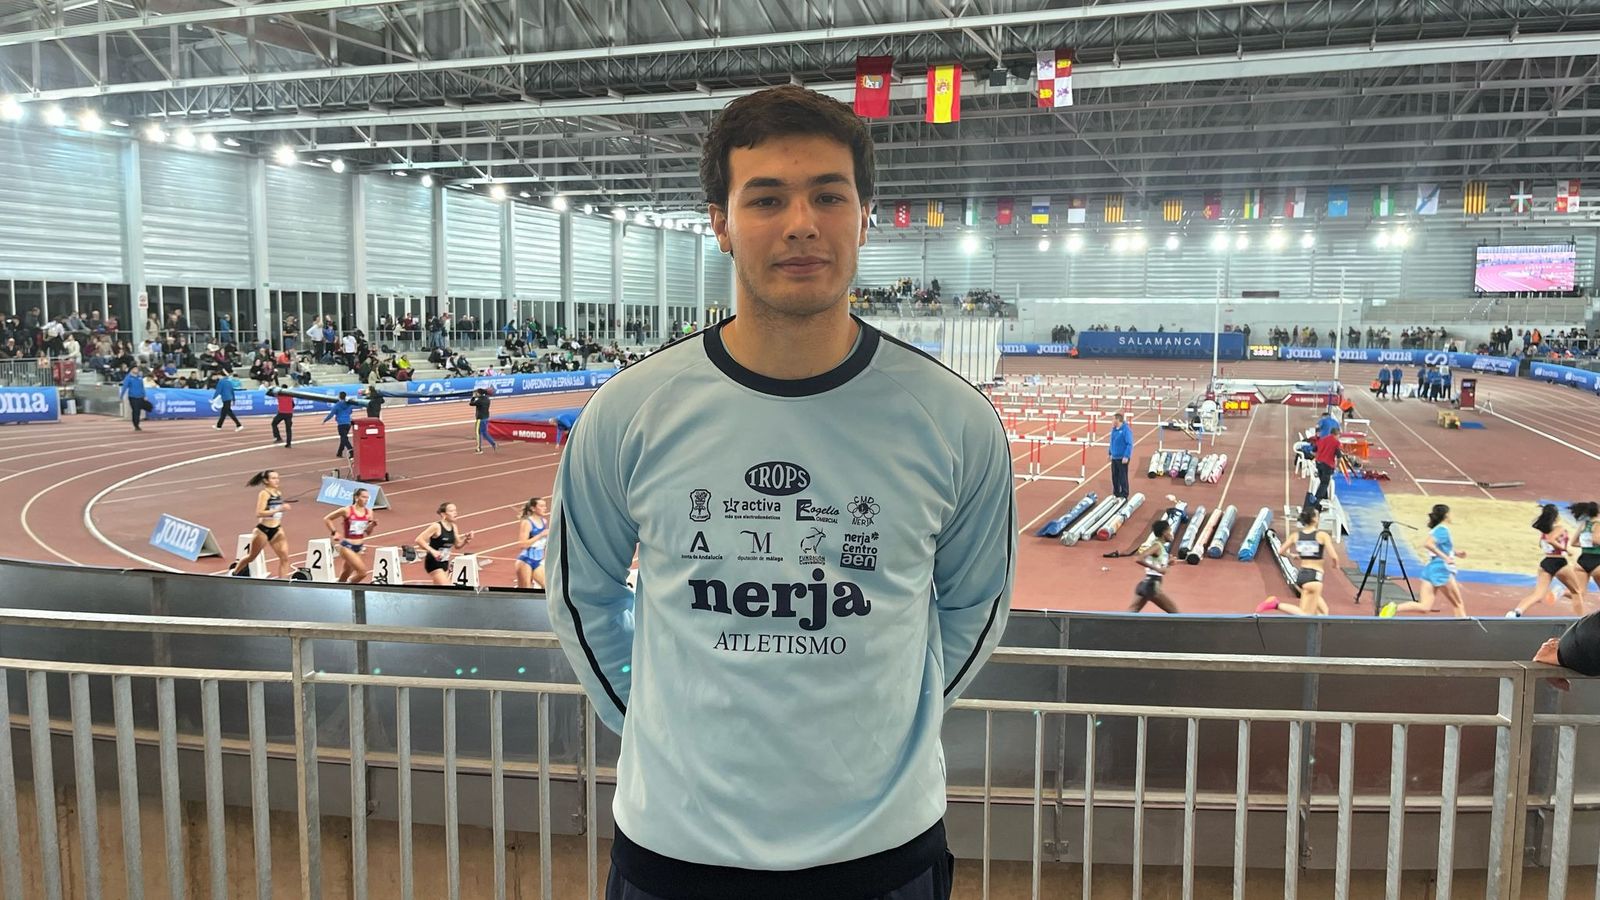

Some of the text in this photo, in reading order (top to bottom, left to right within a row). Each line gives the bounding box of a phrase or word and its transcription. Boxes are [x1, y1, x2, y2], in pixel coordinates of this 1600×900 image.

[1118, 336, 1201, 346] SALAMANCA
[518, 430, 547, 439] MONDO
[748, 463, 808, 490] TROPS
[741, 498, 781, 512] activa
[800, 502, 840, 517] Rogelio
[842, 543, 878, 554] Centro
[311, 549, 322, 569] 2
[379, 558, 388, 577] 3
[841, 554, 876, 567] aen
[457, 565, 468, 584] 4
[688, 568, 872, 631] nerja
[713, 630, 847, 655] ATLETISMO
